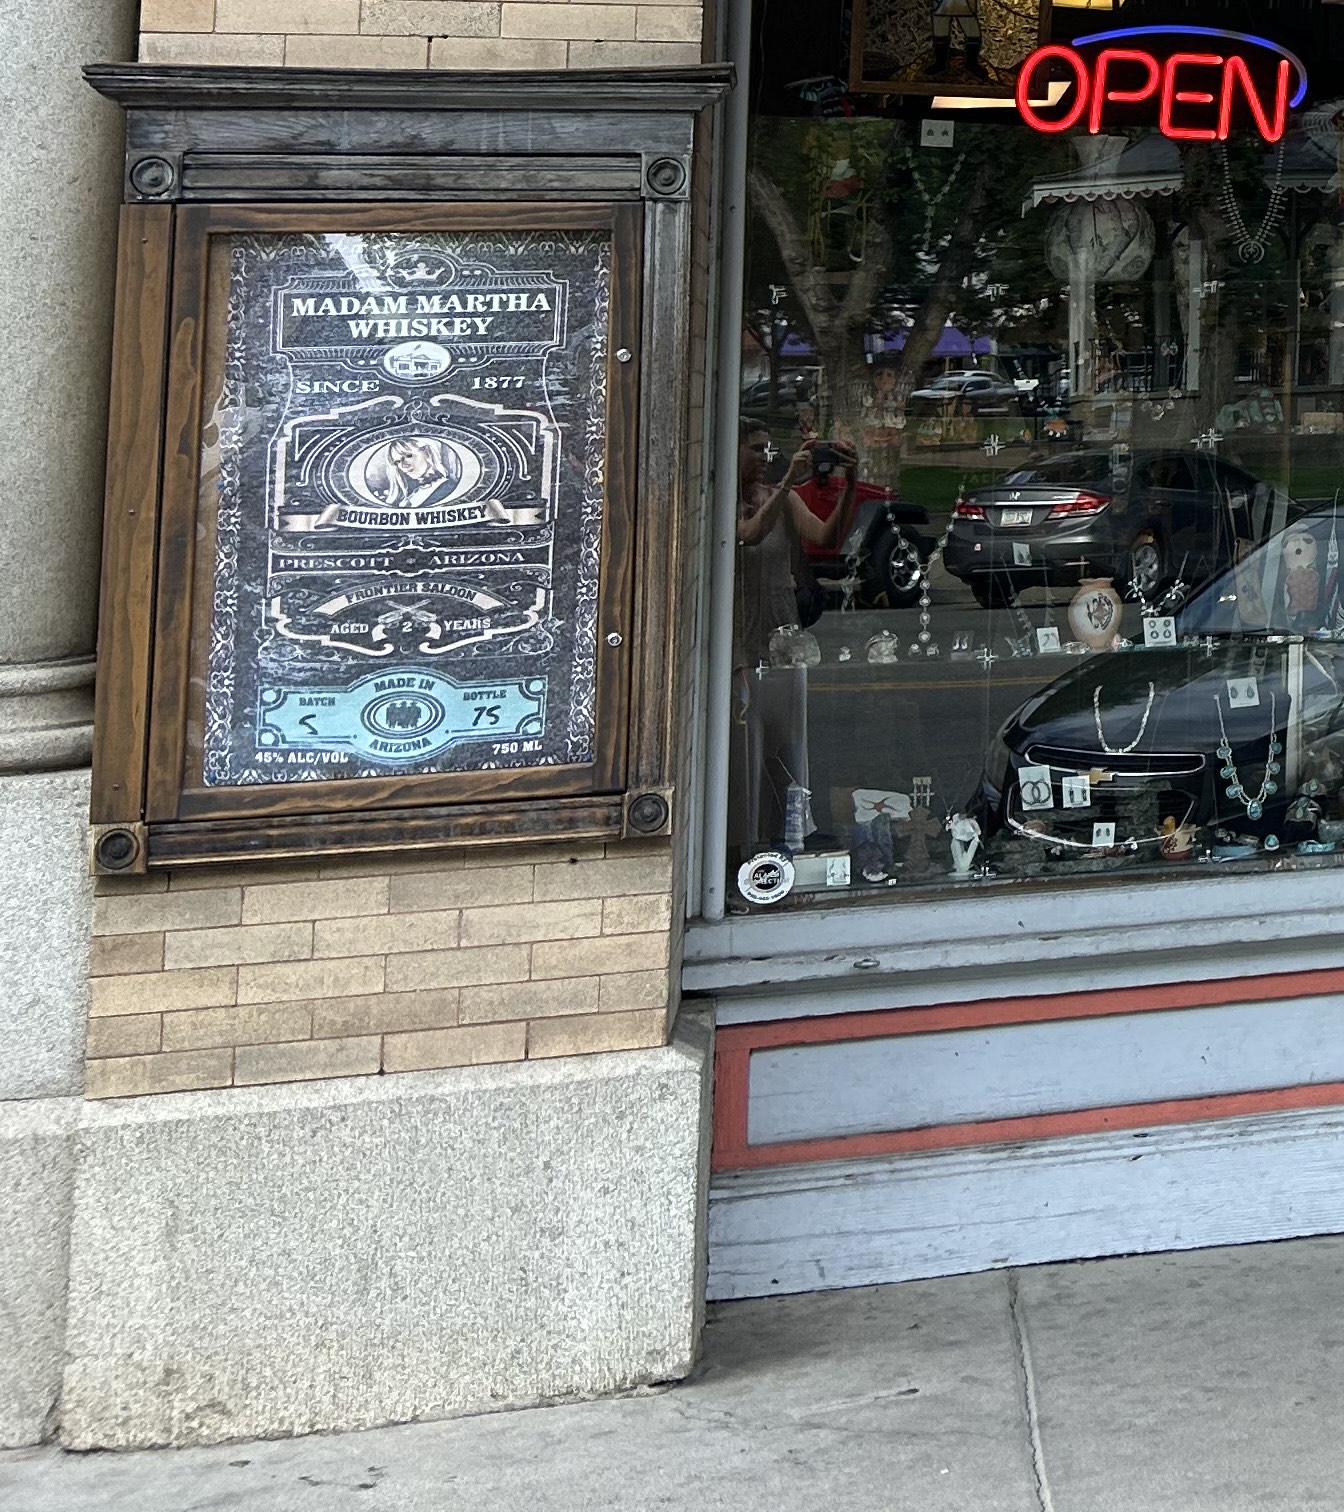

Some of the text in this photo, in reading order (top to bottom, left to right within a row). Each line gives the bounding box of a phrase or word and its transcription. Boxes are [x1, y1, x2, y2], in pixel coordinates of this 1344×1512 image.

[1015, 44, 1290, 143] OPEN
[291, 292, 552, 317] MADAM MARTHA
[347, 316, 494, 339] WHISKEY
[295, 376, 526, 394] SINCE 1877
[337, 504, 487, 526] BOURBON WHISKEY
[278, 552, 526, 569] PRESCOTT ARIZONA
[347, 583, 420, 605] FRONTIER
[330, 623, 369, 635] AGED
[443, 618, 491, 631] YEARS
[374, 677, 436, 693] MADE IN
[298, 696, 336, 707] BATCH
[463, 689, 508, 701] BOTTLE
[368, 737, 433, 753] ARIZONA
[492, 740, 543, 755] 750 ML
[254, 750, 349, 766] 45% ALC/VOL
